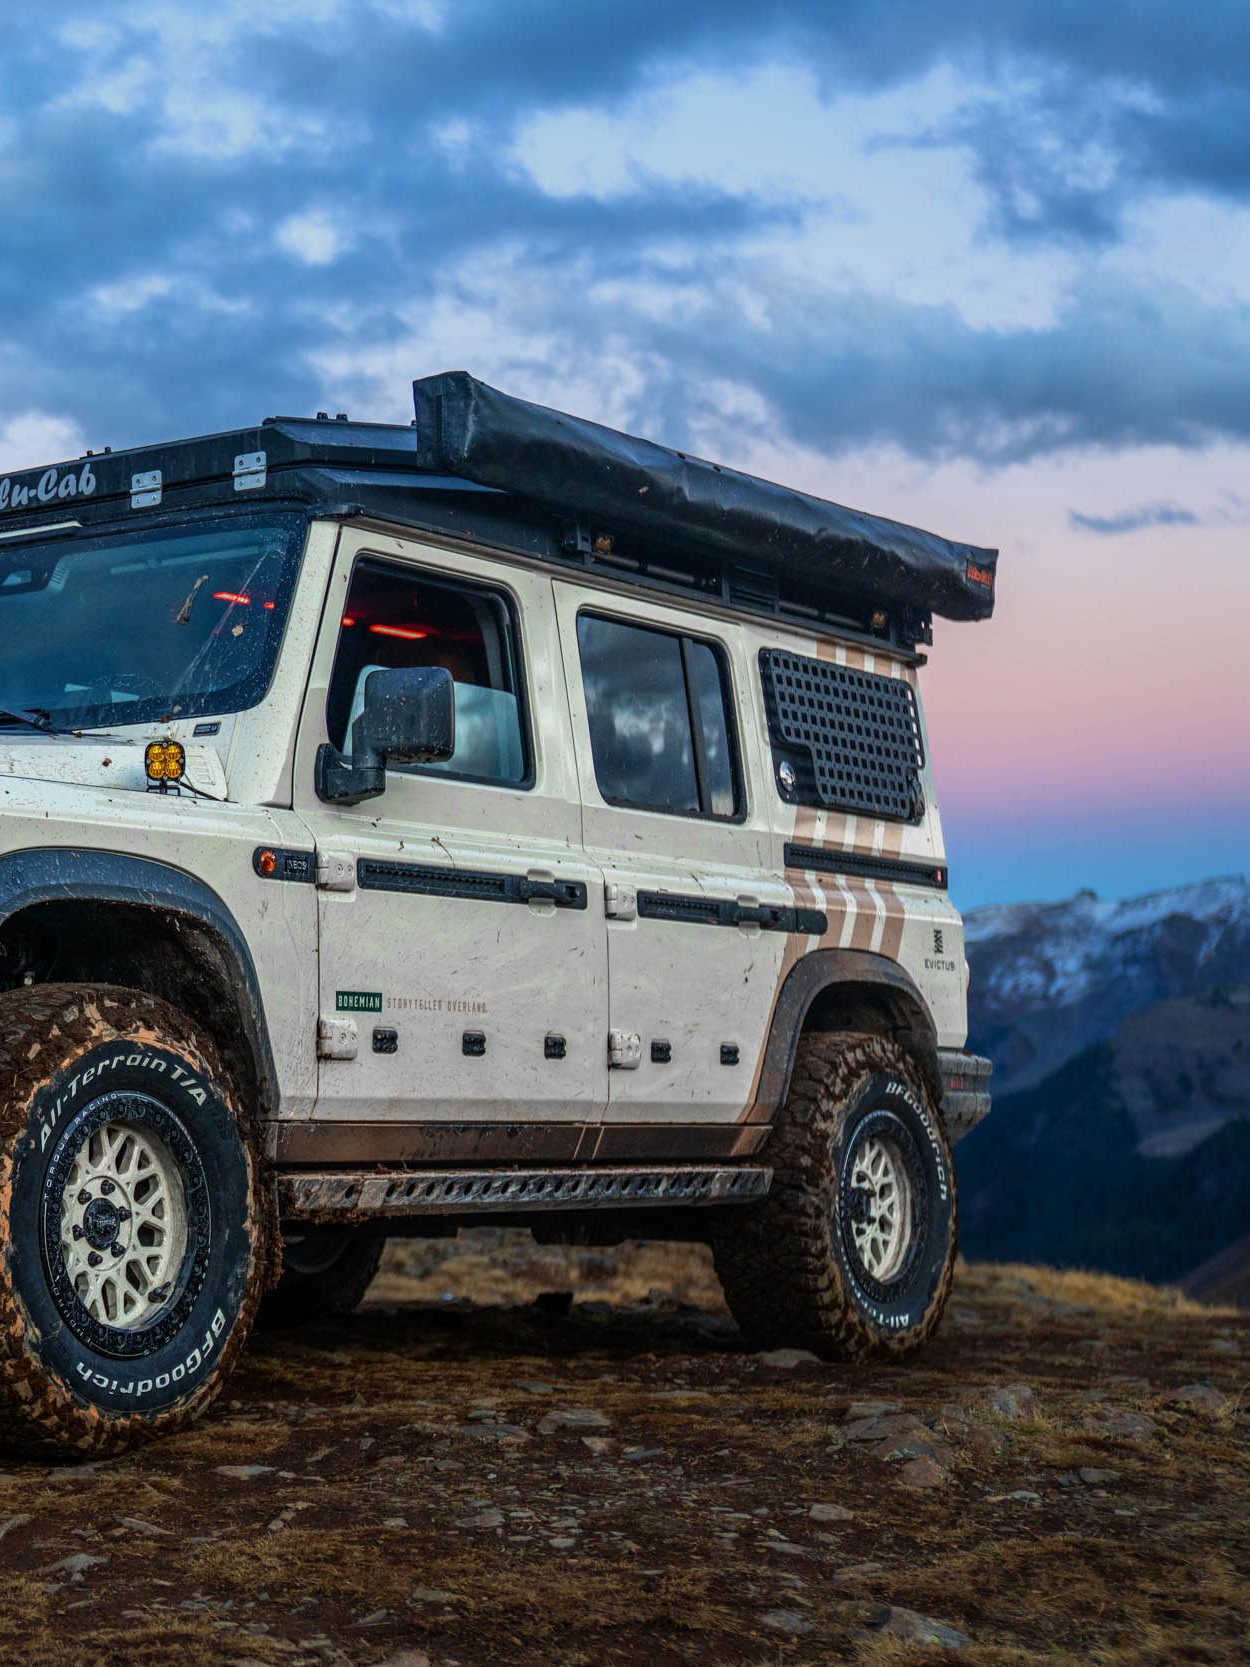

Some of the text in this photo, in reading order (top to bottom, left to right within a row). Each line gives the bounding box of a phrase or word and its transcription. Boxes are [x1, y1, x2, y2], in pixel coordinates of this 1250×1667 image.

[338, 994, 380, 1009] BOHEMIAN
[387, 997, 442, 1012] STORYTELLER
[40, 1052, 167, 1153] All-Terrain
[172, 1064, 209, 1108] T/A
[43, 1093, 117, 1200] TORQUE RACING
[886, 1081, 948, 1201] BFGoodrich
[75, 1307, 227, 1398] BFGoodrich
